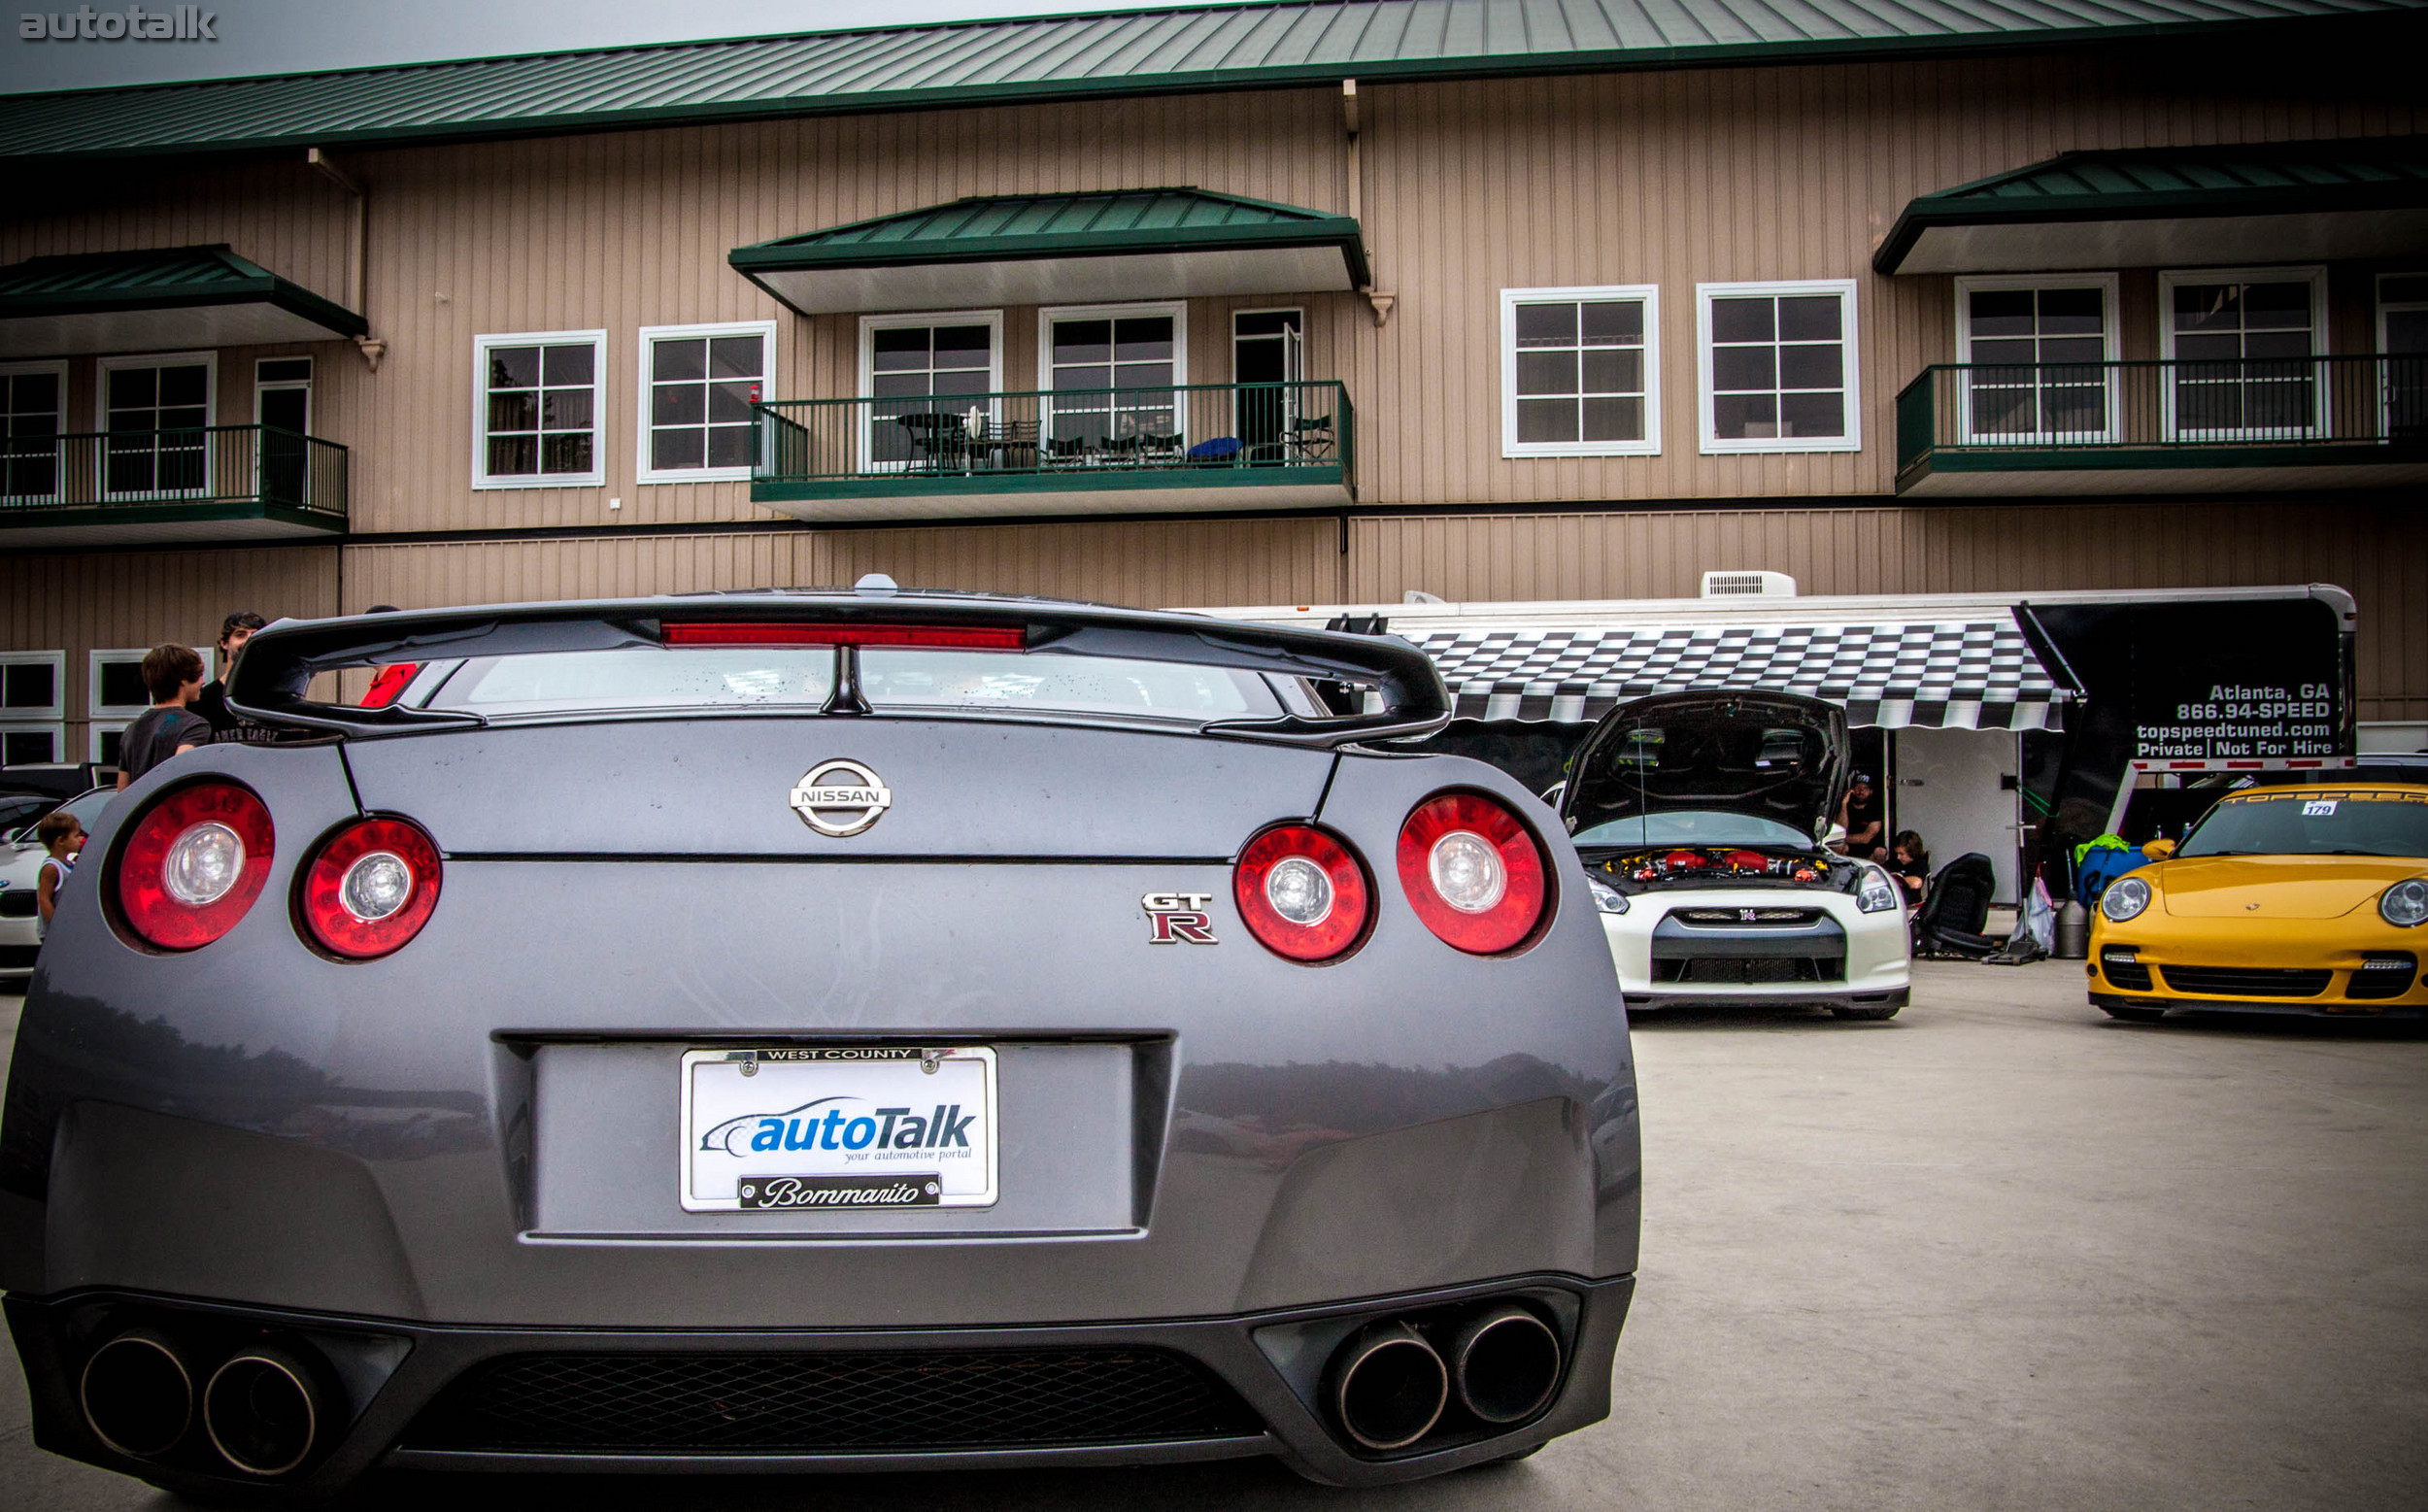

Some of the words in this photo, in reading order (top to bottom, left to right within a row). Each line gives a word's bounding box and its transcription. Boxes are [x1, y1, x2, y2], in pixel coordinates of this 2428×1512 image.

[2209, 685, 2291, 701] Atlanta,
[2300, 684, 2330, 698] GA
[2176, 702, 2330, 720] 866.94-SPEED
[2137, 722, 2330, 742] topspeedtuned.com
[2138, 741, 2203, 756] Private
[2216, 741, 2250, 756] Not
[2257, 741, 2287, 755] For
[2293, 740, 2332, 755] Hire
[801, 790, 880, 802] NISSAN
[2307, 805, 2332, 815] 179
[767, 1050, 819, 1060] WEST
[825, 1049, 911, 1059] COUNTY
[751, 1104, 977, 1152] autoTalk
[845, 1152, 869, 1164] your
[874, 1148, 935, 1160] automotive
[938, 1147, 972, 1162] portal
[759, 1177, 919, 1208] Bommarito
